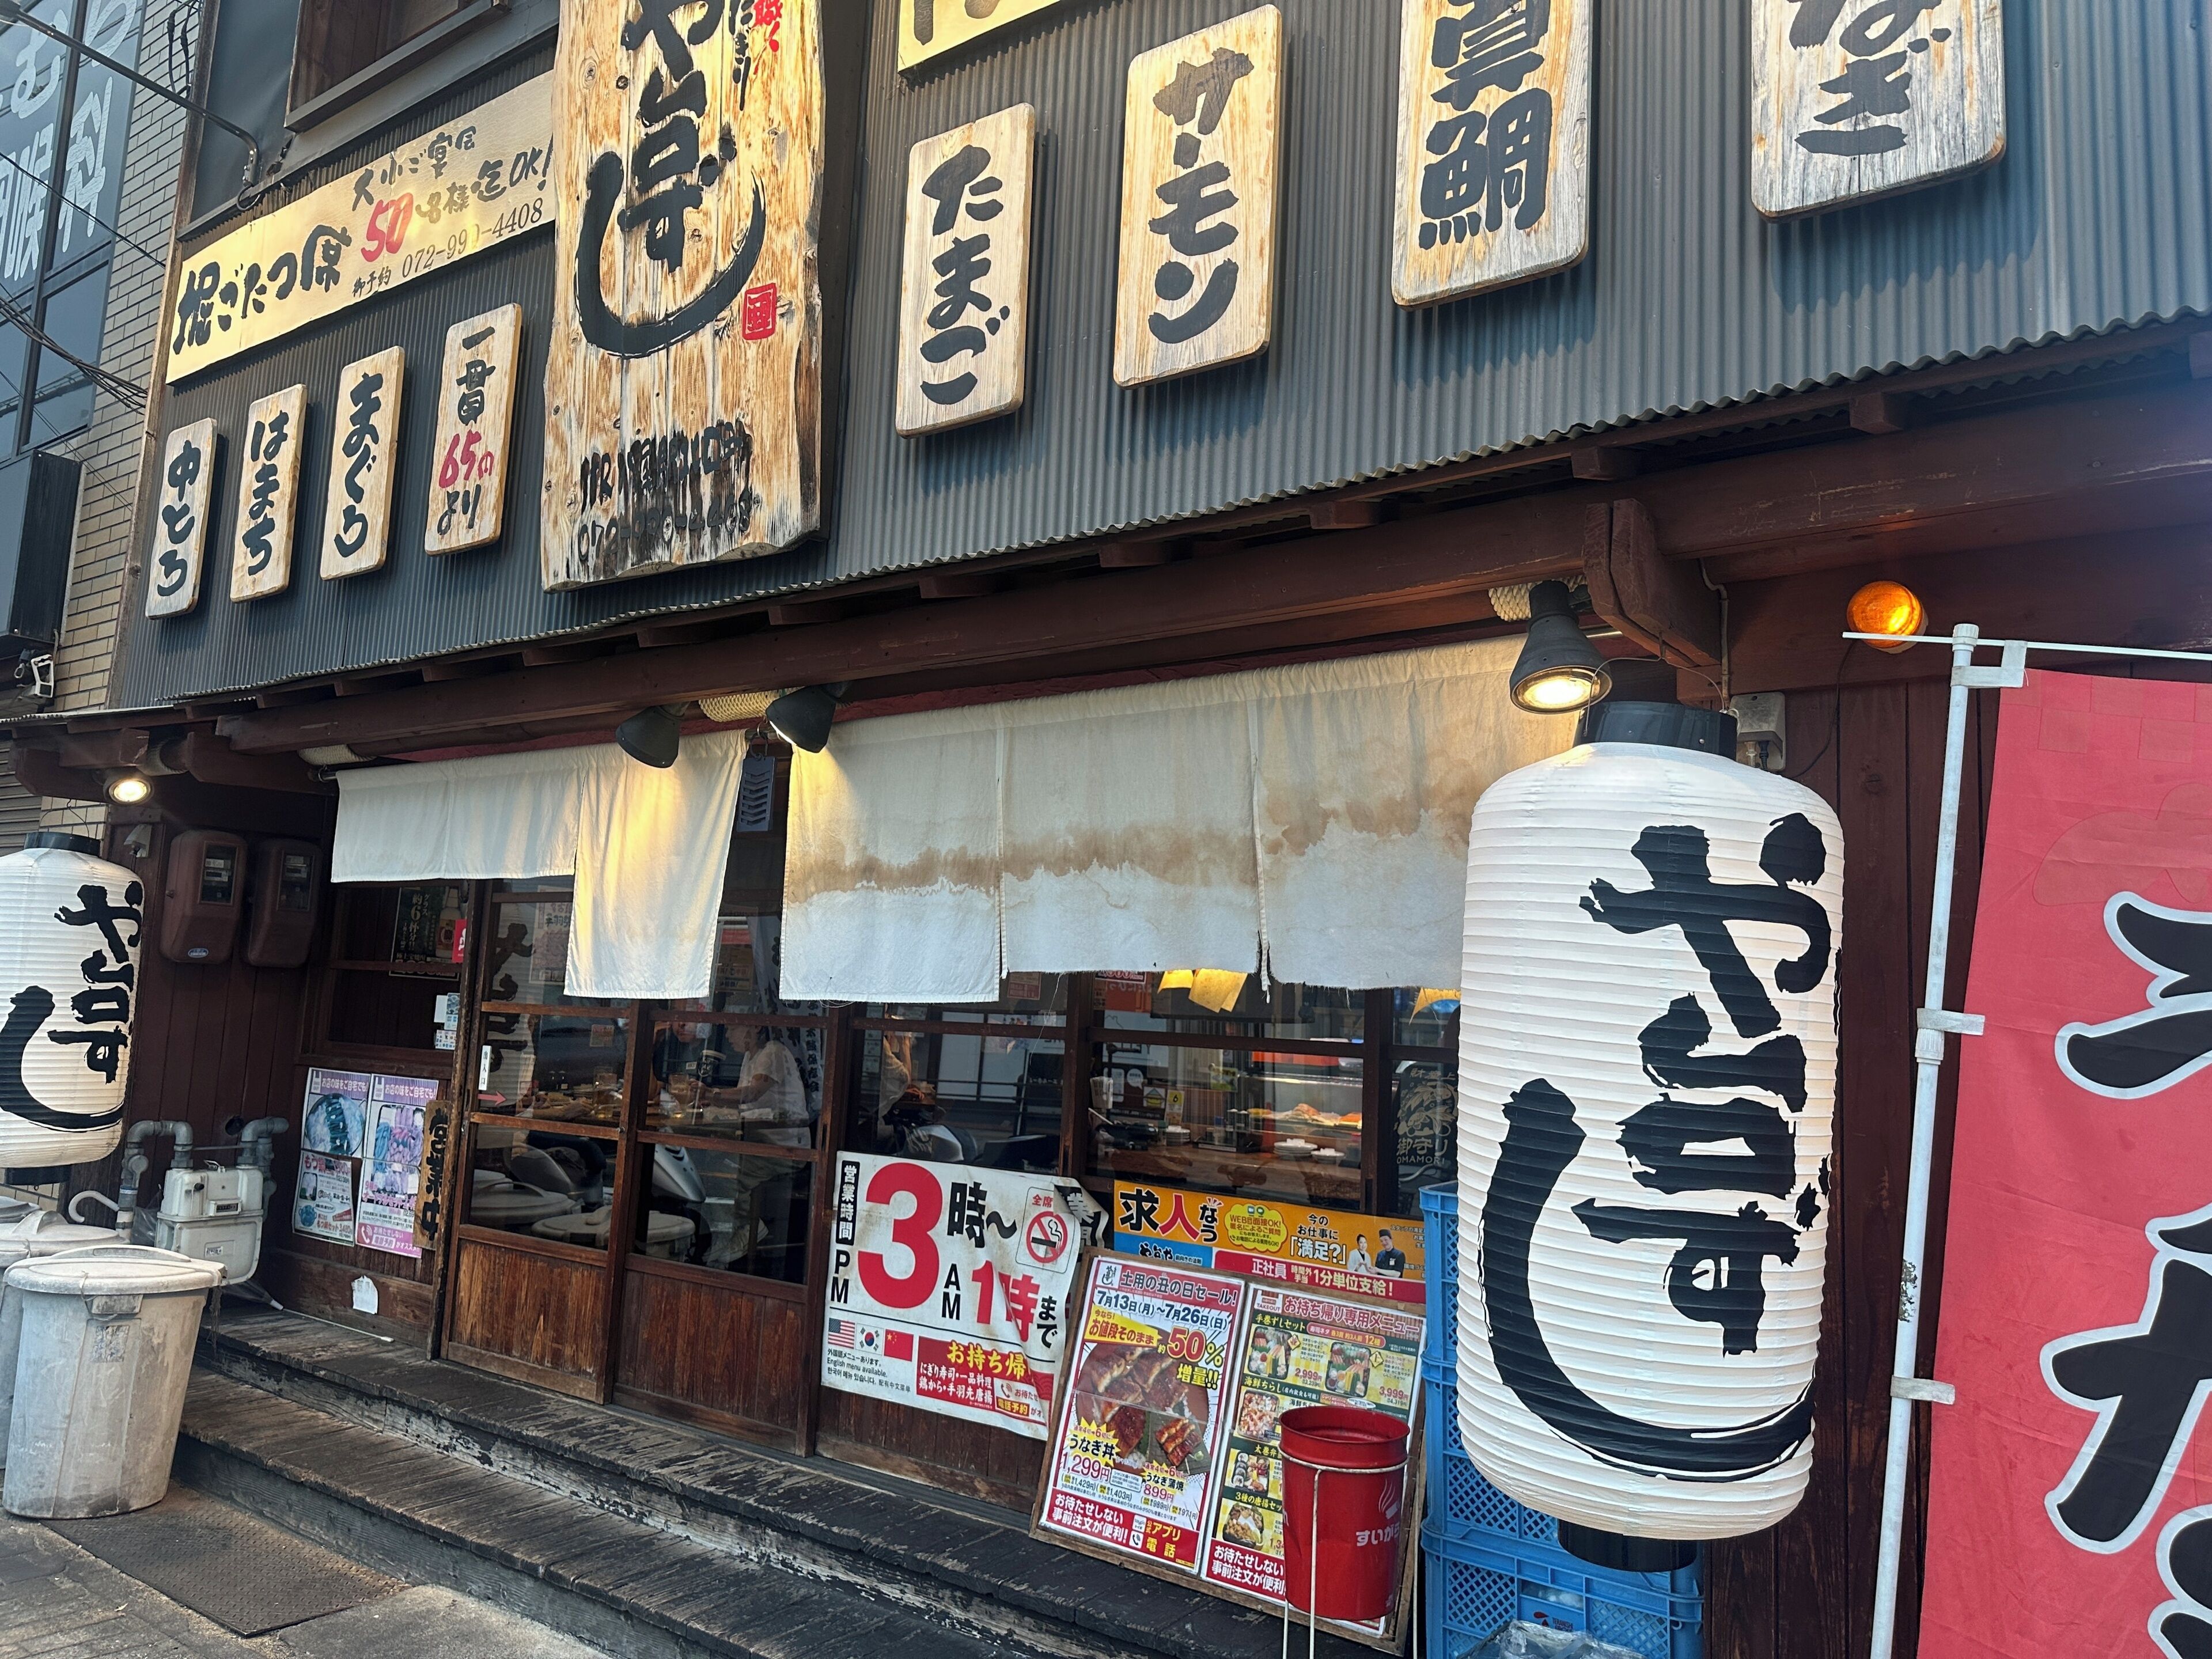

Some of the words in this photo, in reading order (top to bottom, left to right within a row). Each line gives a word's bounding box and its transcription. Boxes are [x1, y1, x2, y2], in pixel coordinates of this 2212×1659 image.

[1148, 47, 1255, 344] サーモン
[920, 145, 1010, 405] たまご
[334, 372, 384, 558] まぐろ
[242, 410, 290, 576] はまち
[157, 440, 202, 597] 中とろ
[480, 1050, 488, 1085] 出入口
[321, 1077, 369, 1093] お店の味をご自宅でも!
[385, 1084, 437, 1100] お店の味をご自宅でも!
[1396, 1137, 1448, 1157] 御守り
[1396, 1155, 1445, 1165] OMAMORI
[840, 1165, 857, 1241] 営業時間
[1032, 1194, 1053, 1208] 全席
[1119, 1188, 1200, 1241] 求人
[1199, 1203, 1219, 1243] なう
[1308, 1213, 1329, 1226] 今の
[1297, 1225, 1339, 1240] お仕事に
[830, 1249, 851, 1304] PM
[1120, 1270, 1237, 1306] 土用の丑の日セール!
[1251, 1257, 1287, 1279] 正社員
[1313, 1268, 1393, 1297] 1分単位支給!
[941, 1263, 961, 1320] AM
[1094, 1309, 1115, 1320] 今なら!
[1256, 1302, 1281, 1313] TAKEOUT
[1283, 1296, 1420, 1335] お持ち帰り専用メニュー
[1037, 1296, 1058, 1349] まで
[1088, 1318, 1155, 1345] お値段そのまま
[1255, 1313, 1306, 1332] 手巻ずしセット
[827, 1348, 882, 1367] 外国語メニューあります。
[827, 1357, 845, 1368] English
[846, 1363, 861, 1372] menu
[862, 1366, 888, 1378] available.
[827, 1366, 843, 1377] 한국어
[854, 1373, 876, 1385] 있습니다.
[919, 1361, 993, 1389] にぎり寿司・一品料理
[1243, 1376, 1282, 1393] 海鮮ちらし
[1294, 1367, 1323, 1381] 2,999円
[919, 1375, 994, 1406] 鶏から・手羽先唐揚
[1379, 1385, 1409, 1401] 3,999円
[997, 1397, 1029, 1415] 電話予約
[1069, 1433, 1116, 1460] うなぎ丼
[1062, 1451, 1110, 1482] 1,299円
[1143, 1483, 1174, 1502] 899円
[1146, 1472, 1184, 1492] うなぎ蒲焼
[1054, 1493, 1124, 1524] お待たせしない
[1051, 1506, 1129, 1544] 事前注文が便利!
[1152, 1521, 1181, 1541] アプリ
[1146, 1537, 1177, 1558] 電話
[1214, 1545, 1283, 1576] お待たせしない
